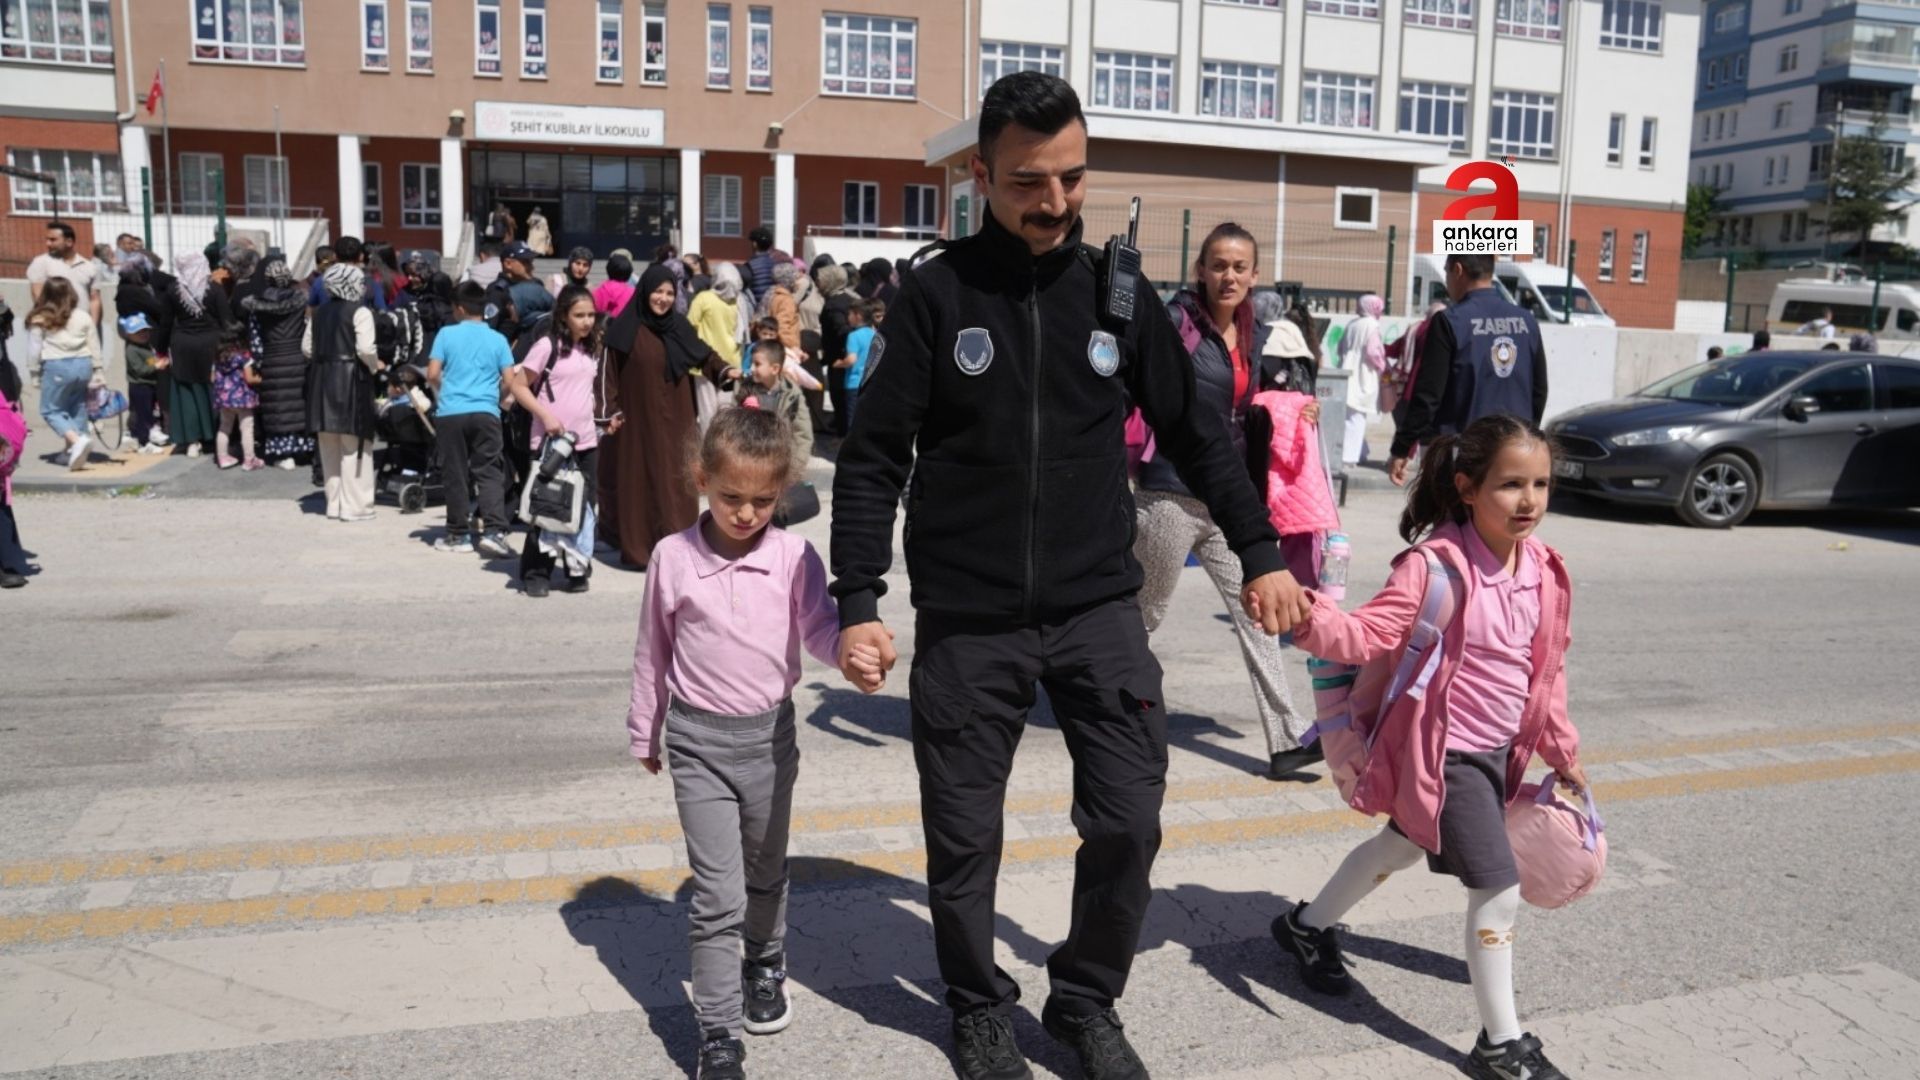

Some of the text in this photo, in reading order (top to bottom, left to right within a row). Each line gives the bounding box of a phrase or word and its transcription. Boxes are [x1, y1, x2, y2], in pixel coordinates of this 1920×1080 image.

[510, 121, 651, 138] ŞEHİT KUBİLAY İLKOKULU
[1471, 317, 1529, 336] ZABITA
